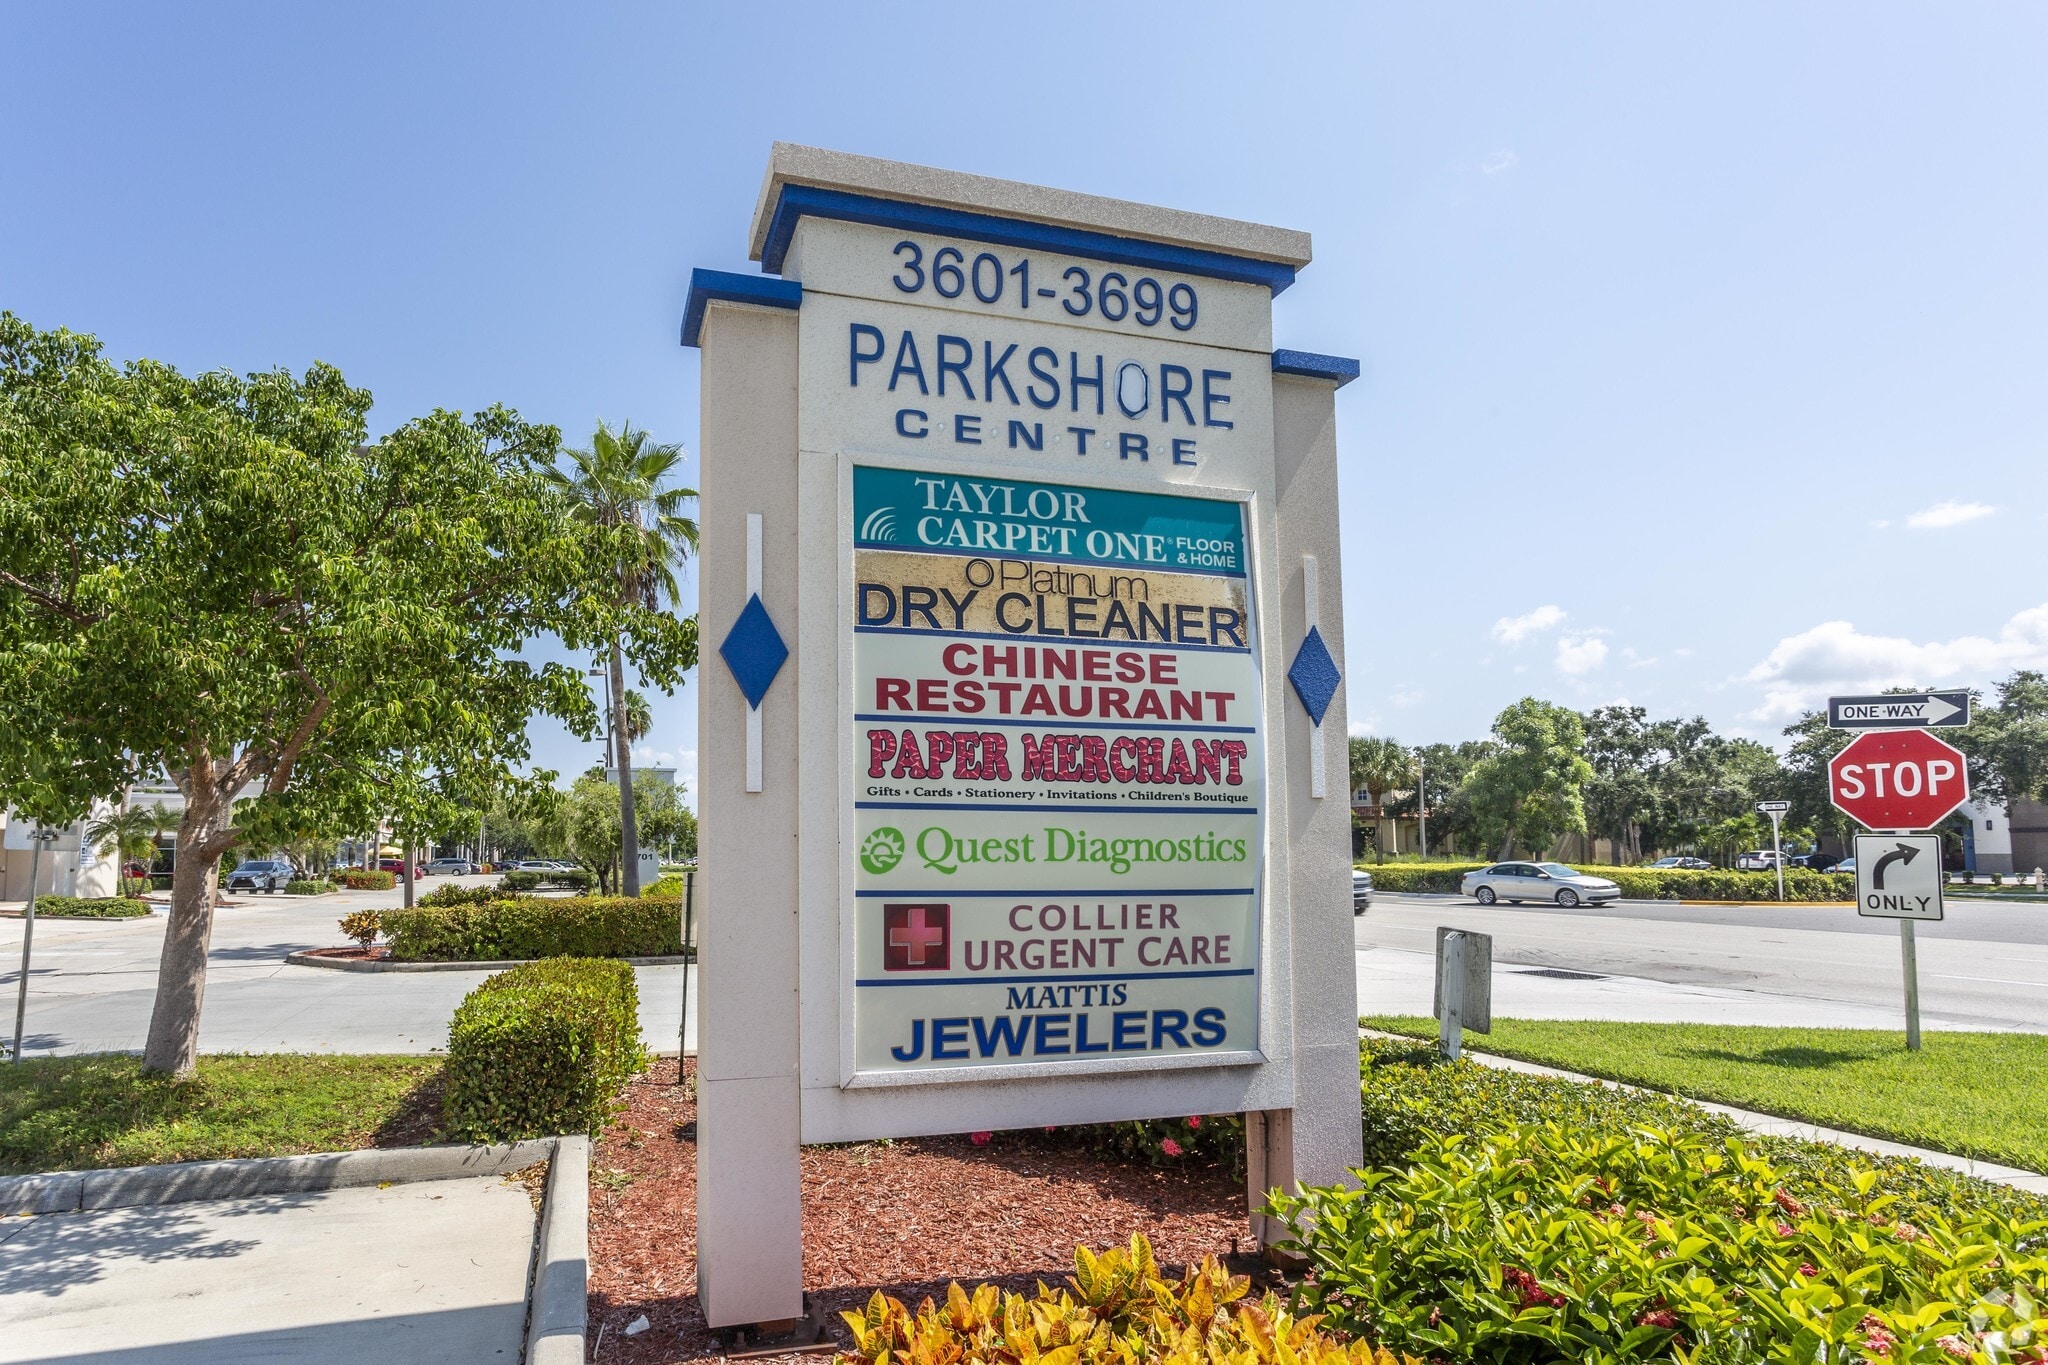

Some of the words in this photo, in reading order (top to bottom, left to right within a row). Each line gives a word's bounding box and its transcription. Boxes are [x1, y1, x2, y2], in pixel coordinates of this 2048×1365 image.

[892, 241, 1198, 331] 3601-3699
[849, 322, 1234, 430] PARKSHORE
[895, 409, 1198, 467] CENTRE
[914, 476, 1091, 524] TAYLOR
[916, 516, 1077, 556] CARPET
[1176, 536, 1235, 554] FLOOR
[1001, 559, 1149, 601] Platinum
[1176, 553, 1188, 565] &
[1190, 554, 1236, 569] HOME
[858, 583, 979, 631] DRY
[995, 592, 1246, 648] CLEANER
[942, 643, 1179, 686] CHINESE
[875, 677, 1236, 723] RESTAURANT
[1843, 705, 1880, 719] ONE
[1886, 704, 1925, 717] WAY
[866, 728, 1013, 781] PAPER
[1020, 733, 1248, 787] MERCHANT
[866, 785, 901, 798] Gifts
[913, 786, 953, 799] Cards
[965, 788, 1036, 802] Stationery
[1046, 788, 1117, 801] Invitations
[1128, 789, 1190, 802] Children's
[1193, 791, 1249, 804] Boutique
[1839, 759, 1956, 800] STOP
[915, 826, 1036, 876] Quest
[1043, 827, 1247, 875] Diagnostics
[1008, 903, 1181, 933] COLLIER
[1867, 894, 1931, 912] ONLY
[963, 937, 1124, 972] URGENT
[1137, 935, 1232, 967] CARE
[1005, 982, 1128, 1011] MATTIS
[890, 1006, 1228, 1063] JEWELERS
